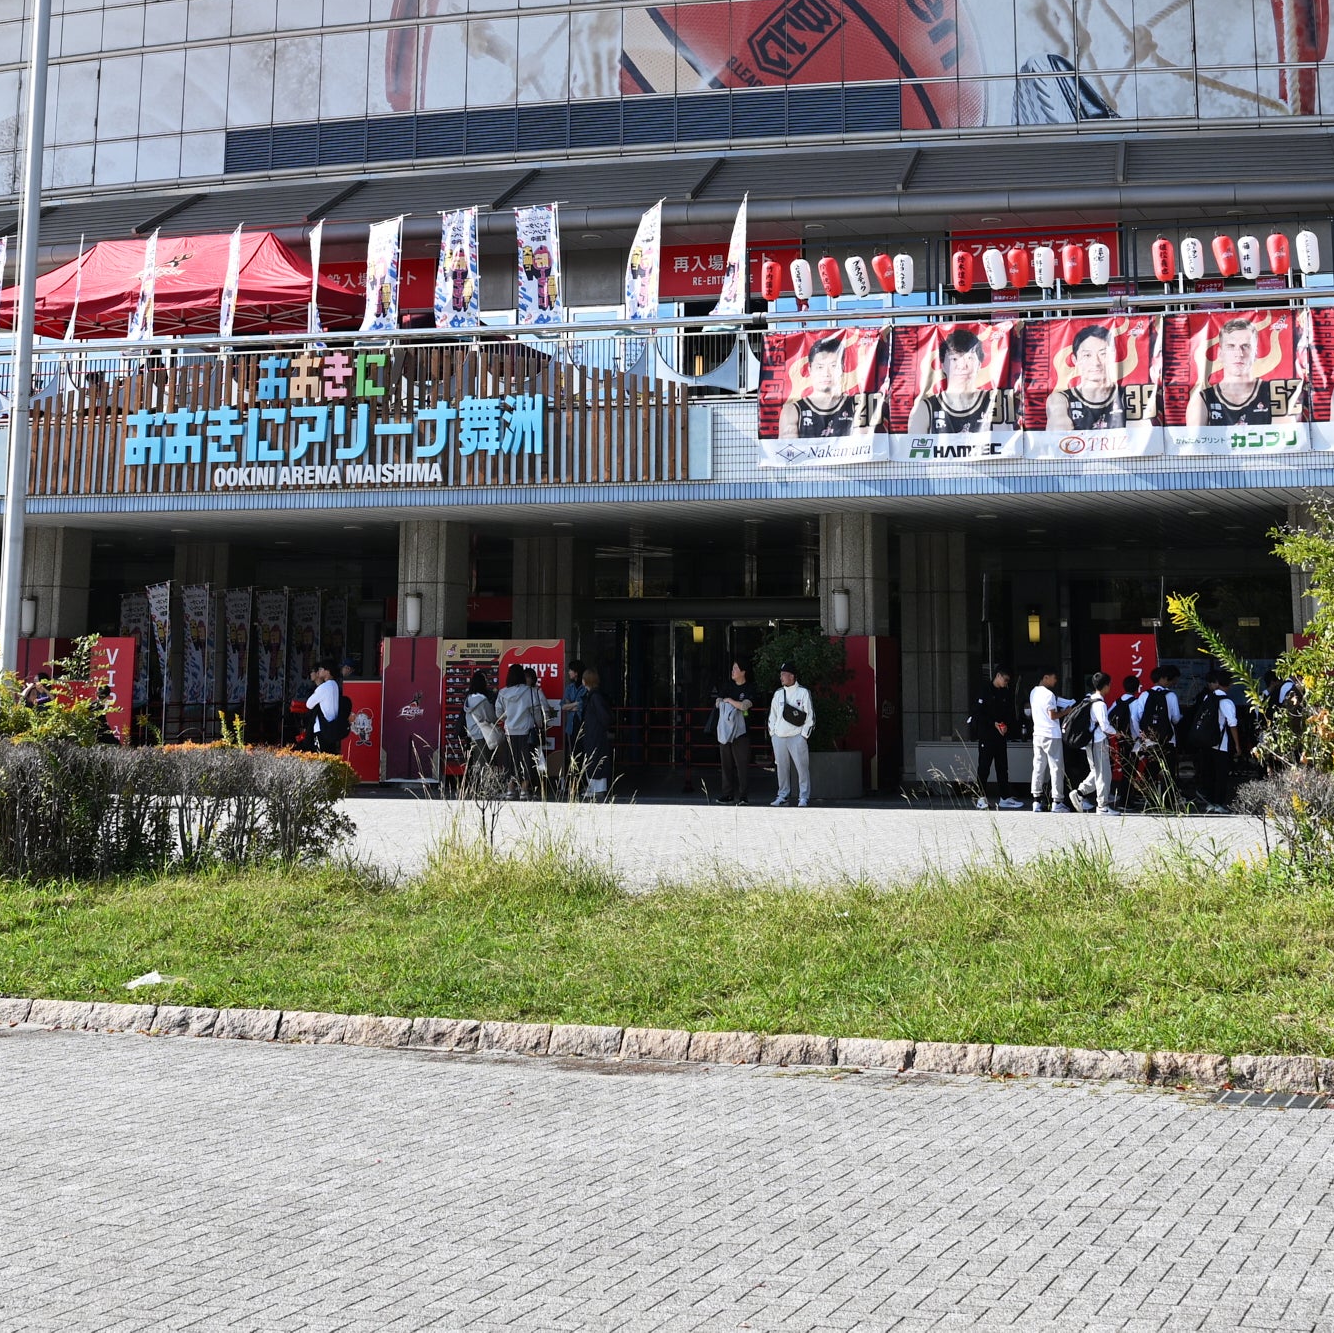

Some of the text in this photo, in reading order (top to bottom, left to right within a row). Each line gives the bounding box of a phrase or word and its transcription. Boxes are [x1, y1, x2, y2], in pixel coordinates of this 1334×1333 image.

[673, 252, 773, 273] 再入場ート
[693, 274, 754, 286] RE-ENTRE
[258, 352, 388, 400] おおきに
[1269, 379, 1303, 416] 52
[124, 393, 545, 466] おおきにアリーナ舞洲
[1230, 429, 1298, 448] カンプリ
[807, 443, 871, 459] Nakamura
[214, 463, 443, 487] OOKINI ARENA MAISHIMA
